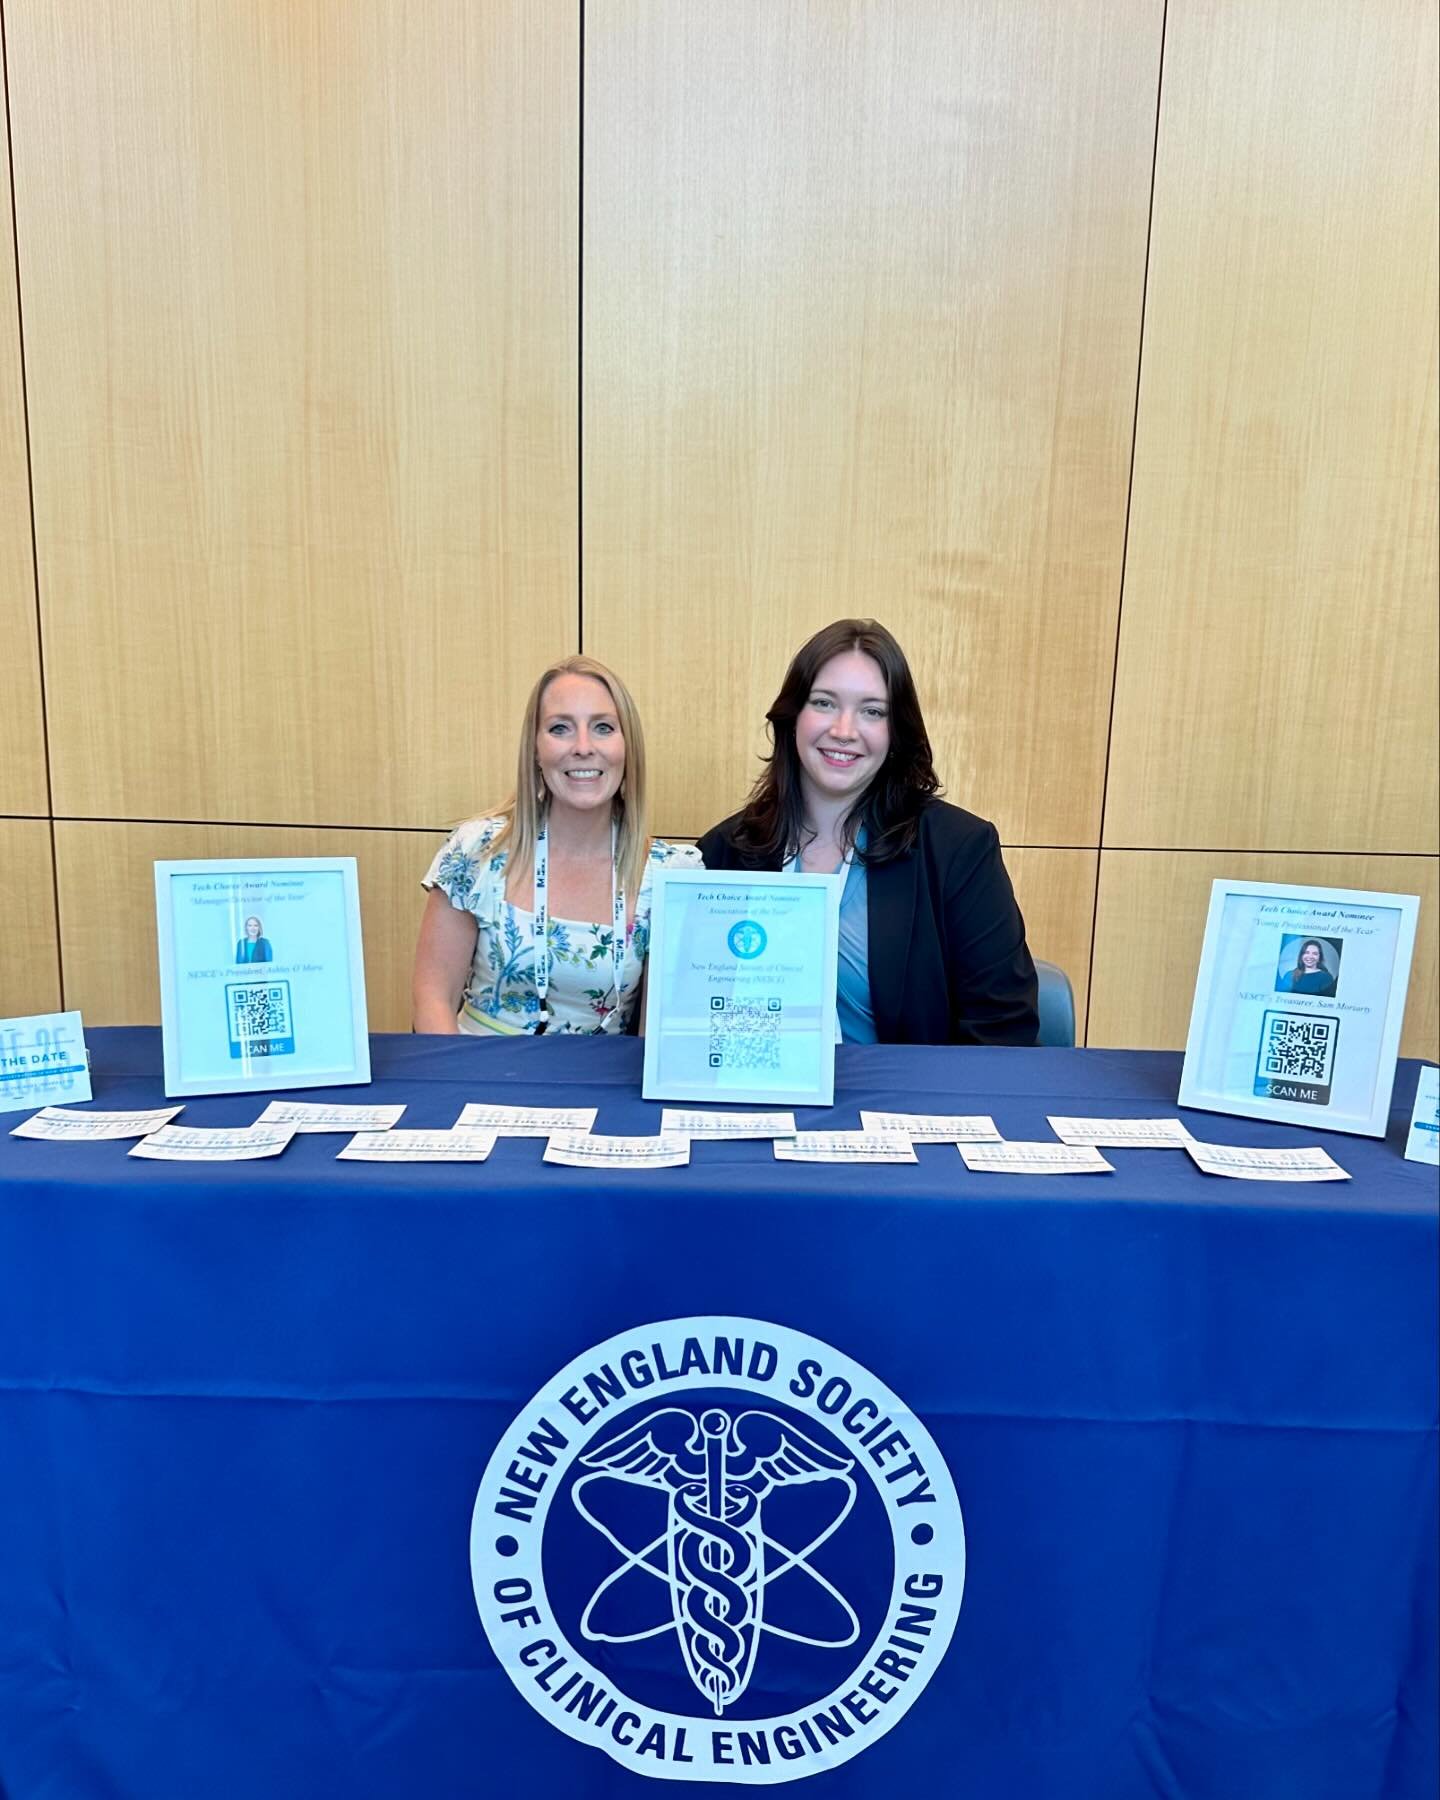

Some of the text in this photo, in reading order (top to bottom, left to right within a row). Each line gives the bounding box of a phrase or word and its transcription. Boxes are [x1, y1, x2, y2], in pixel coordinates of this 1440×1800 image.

[1260, 904, 1279, 913] Tech
[1311, 908, 1336, 918] Award
[1339, 911, 1375, 920] Nominee
[1317, 999, 1335, 1009] Sam
[270, 1042, 285, 1052] ME
[1, 1051, 67, 1067] THE DATE
[1266, 1083, 1318, 1100] SCAN ME
[494, 1336, 937, 1523] NEW ENGLAND SOCIETY
[493, 1573, 944, 1766] OF CLINICAL ENGINEERING
